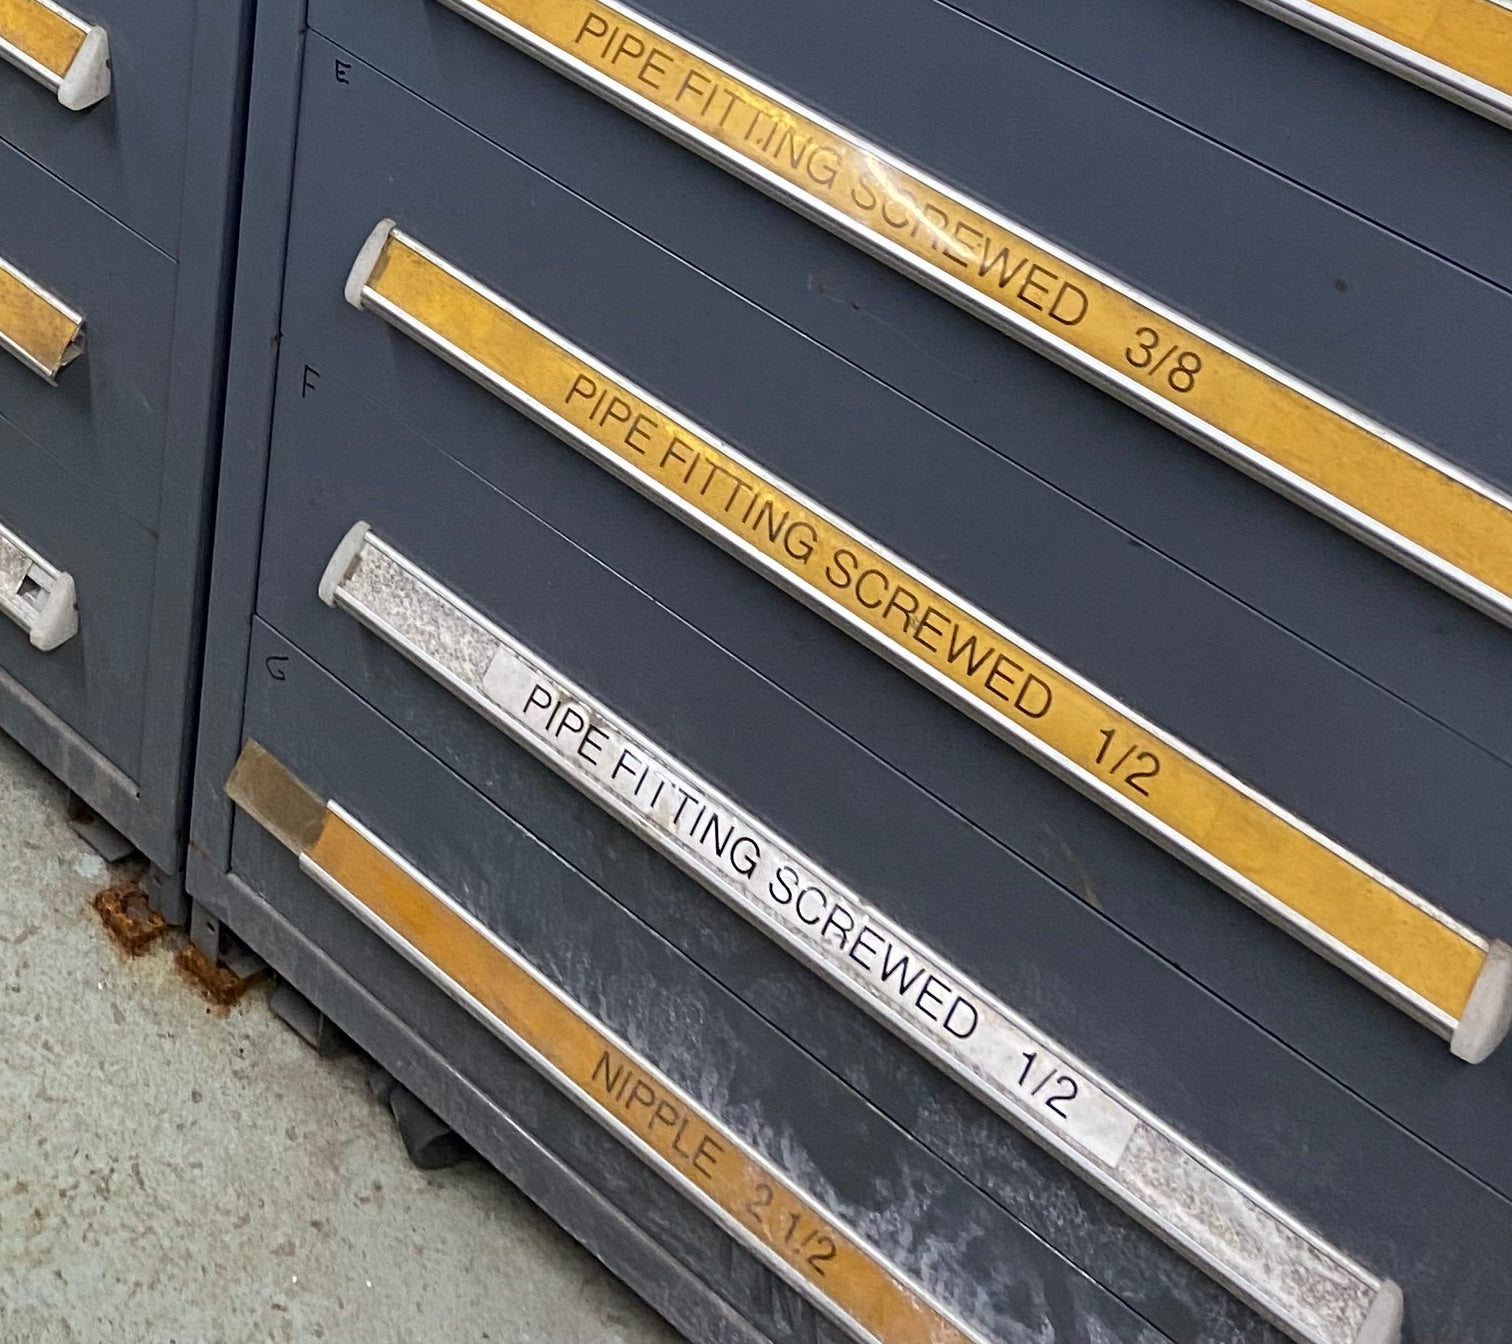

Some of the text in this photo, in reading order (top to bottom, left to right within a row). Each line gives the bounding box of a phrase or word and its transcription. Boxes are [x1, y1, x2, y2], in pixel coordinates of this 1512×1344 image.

[335, 58, 353, 86] E
[573, 9, 1206, 395] PIPE FITTING SCREWED 3/8
[300, 364, 321, 399] F
[265, 656, 290, 682] G
[564, 373, 1167, 799] PIPE FITTING SCREWED 1/2
[524, 685, 1080, 1120] PIPE FITTING SCREWED 1/2
[591, 1050, 839, 1278] NIPPLE 2 1/2
